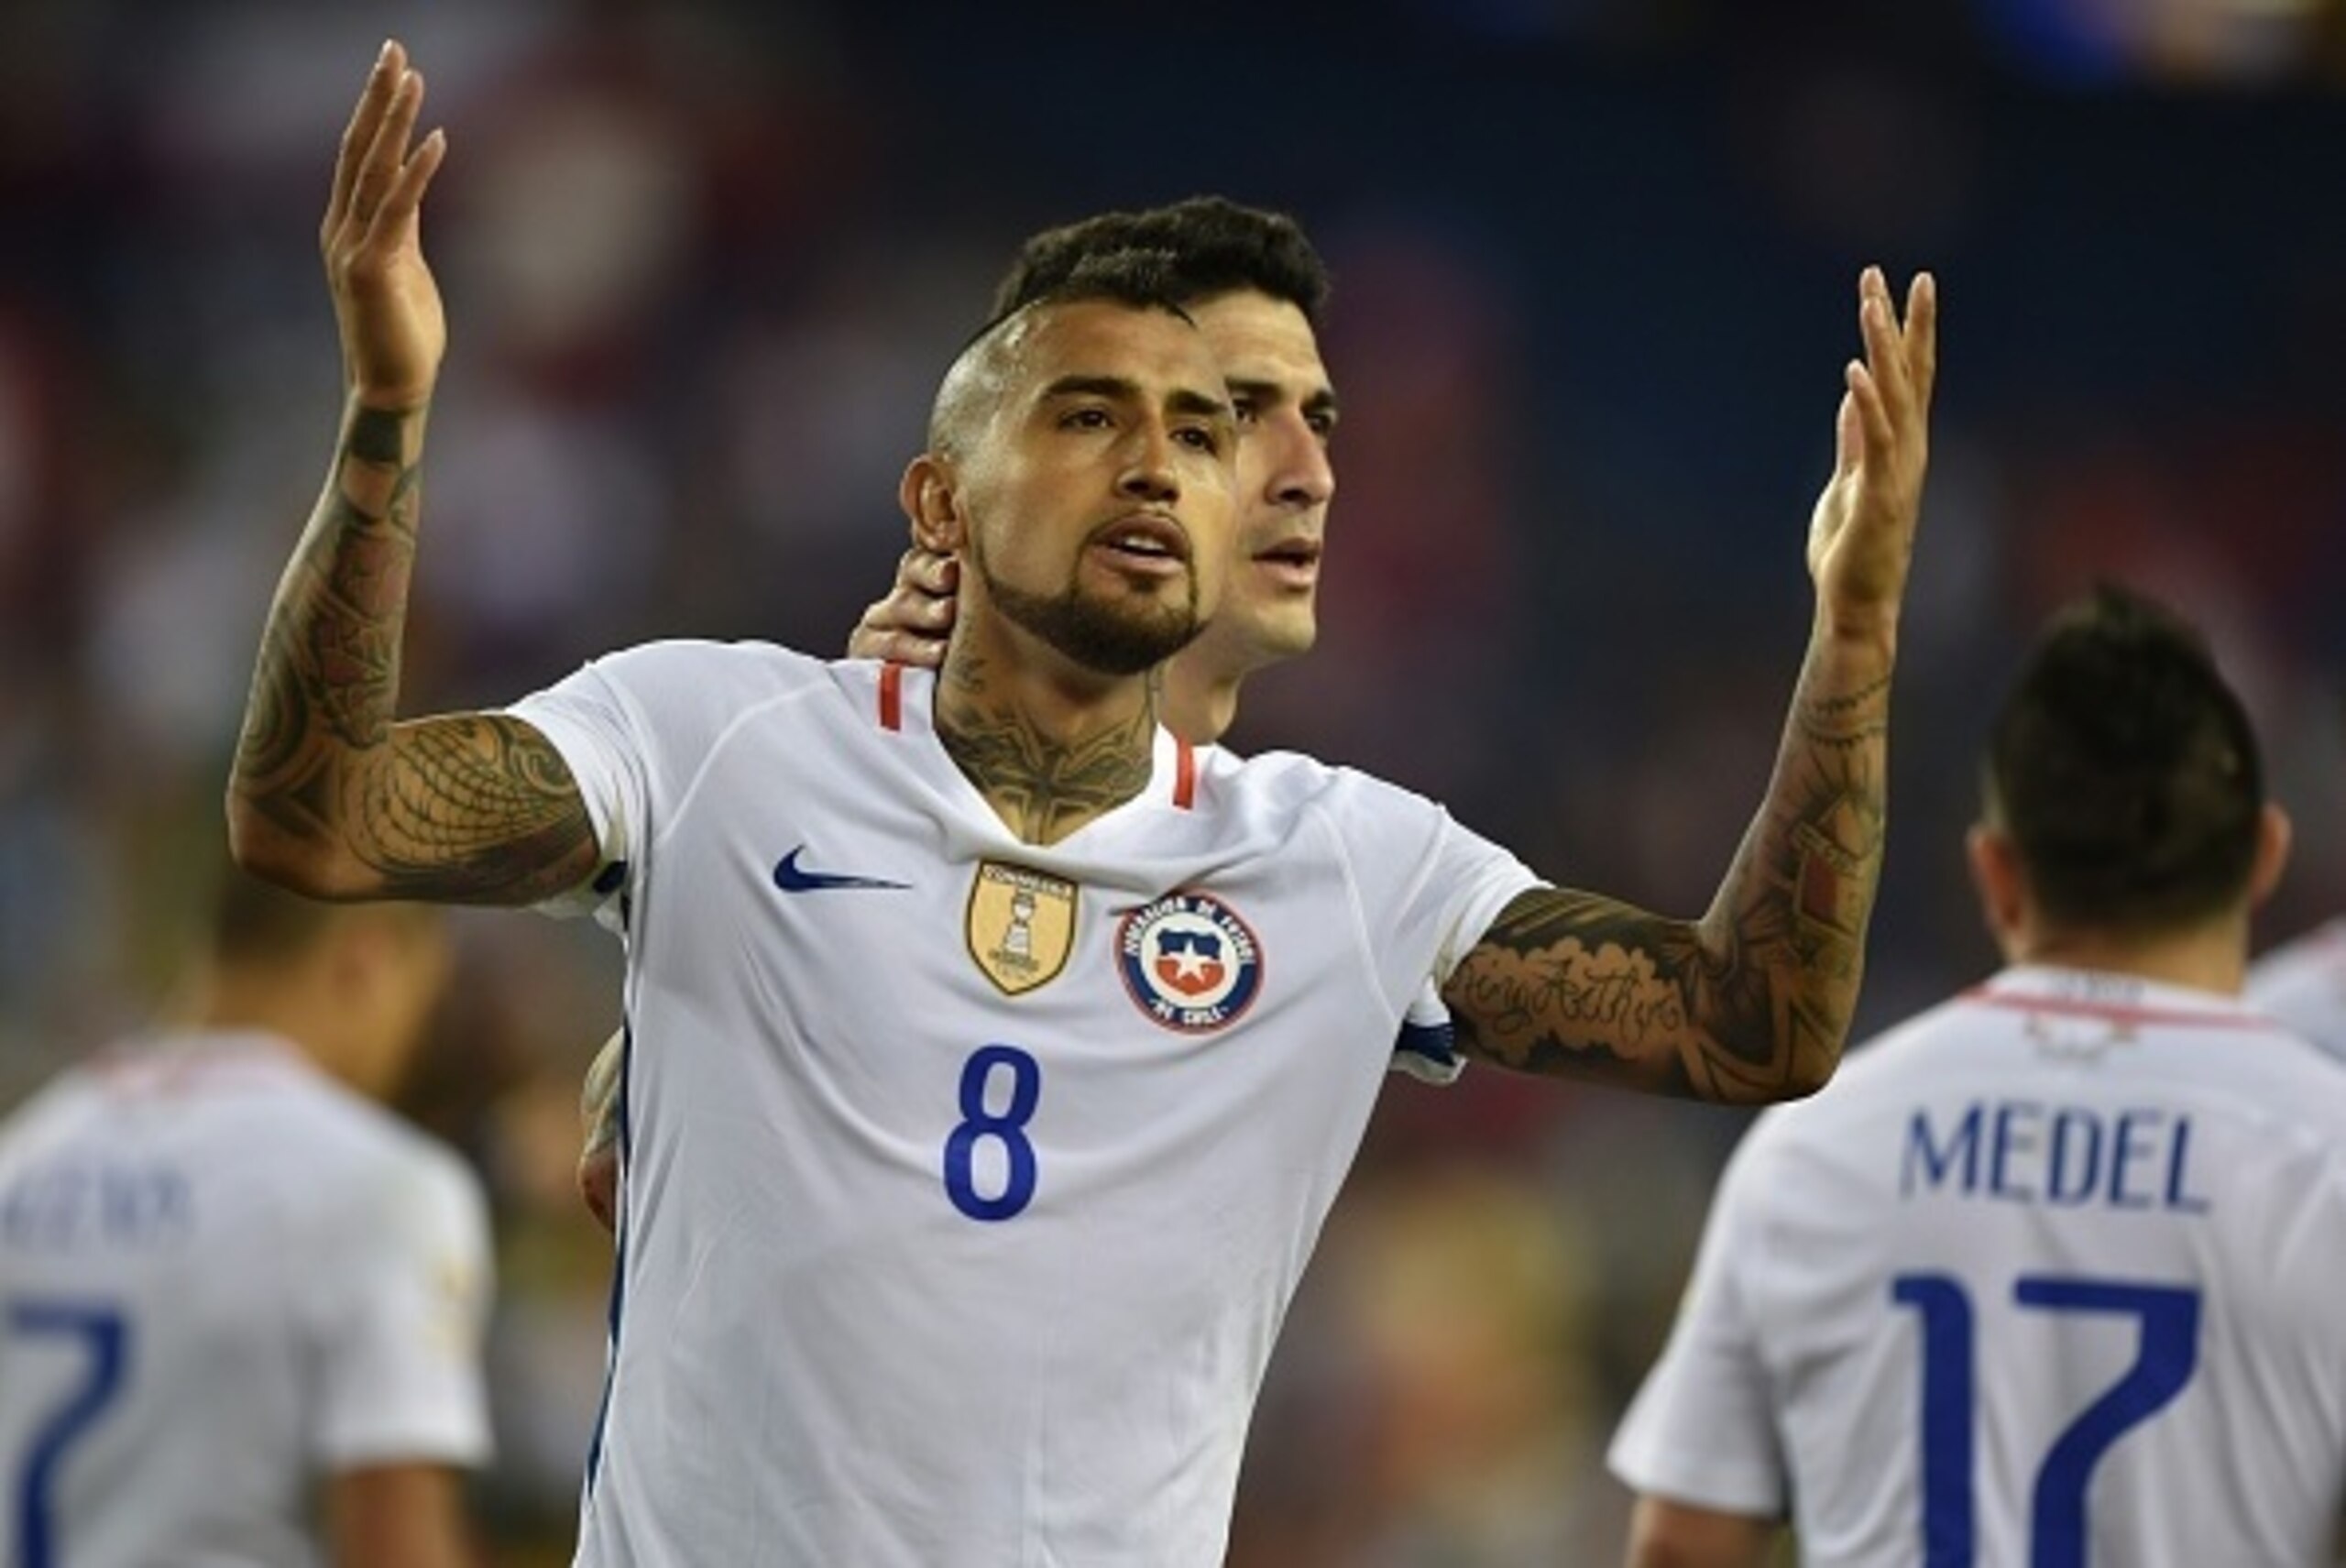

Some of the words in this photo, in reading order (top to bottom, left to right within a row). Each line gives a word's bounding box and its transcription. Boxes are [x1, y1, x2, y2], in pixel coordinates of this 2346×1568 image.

[944, 1044, 1040, 1222] 8
[1902, 1102, 2210, 1213] MEDEL
[1891, 1276, 2201, 1568] 17
